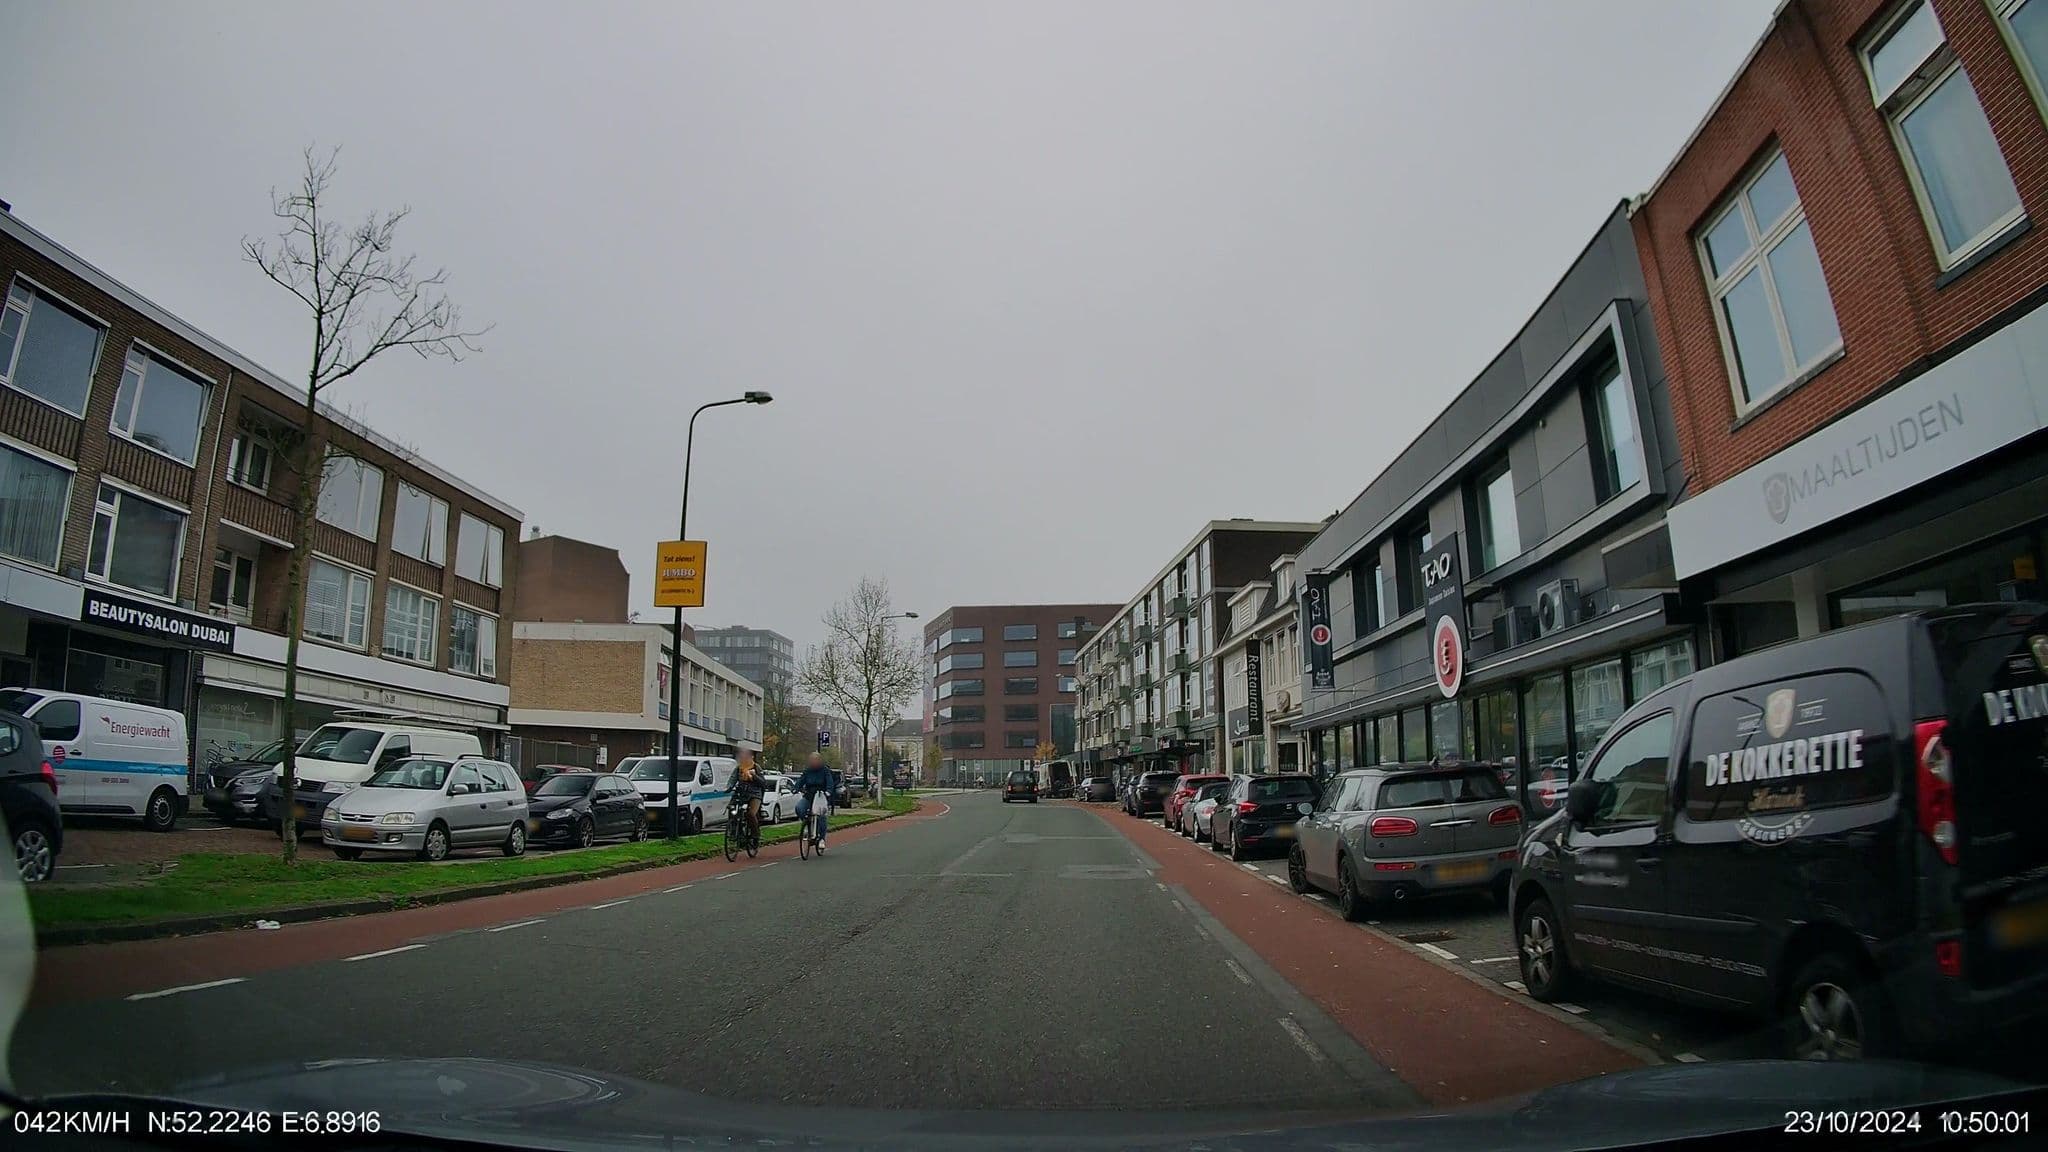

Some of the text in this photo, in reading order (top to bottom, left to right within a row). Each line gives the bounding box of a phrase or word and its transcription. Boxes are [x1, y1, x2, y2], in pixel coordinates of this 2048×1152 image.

[1790, 393, 1964, 502] MAALTIJDEN
[1421, 552, 1451, 587] TAO
[89, 599, 230, 644] BEAUTYSALON DUBAI
[1248, 655, 1259, 722] Restaurant
[1983, 690, 2016, 726] DE
[111, 721, 171, 738] Energiewacht
[1705, 729, 1864, 787] DE KOKKERETTE
